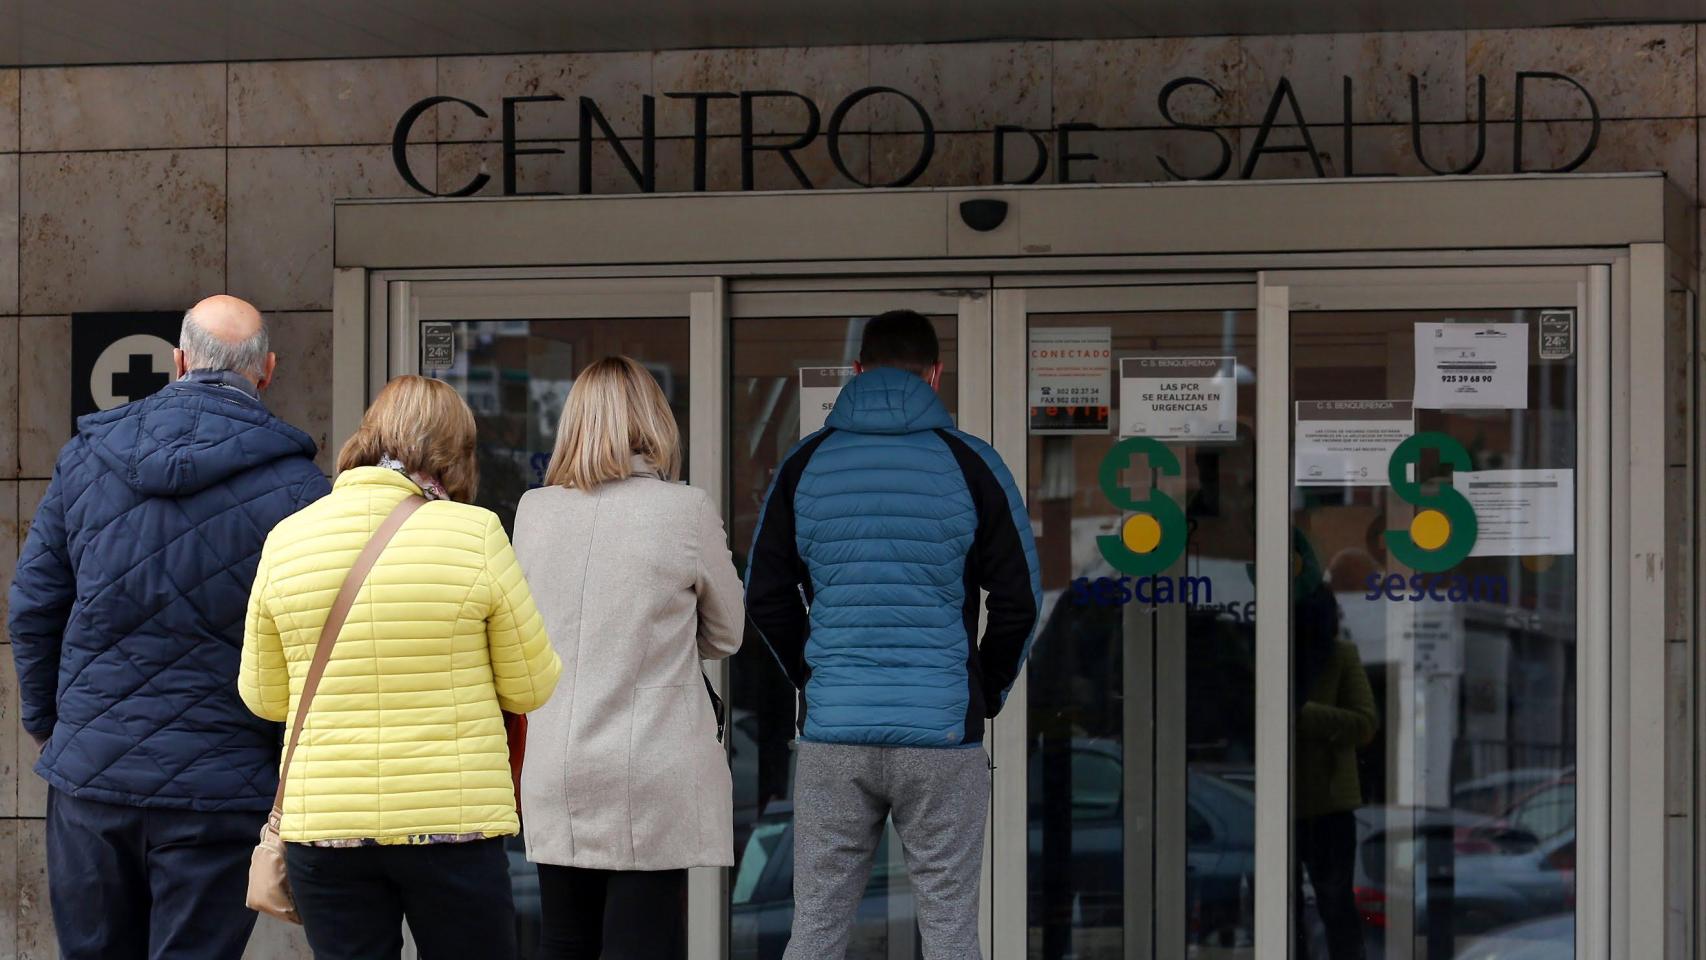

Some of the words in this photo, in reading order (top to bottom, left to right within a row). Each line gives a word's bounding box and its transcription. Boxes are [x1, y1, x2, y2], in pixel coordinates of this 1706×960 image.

[392, 86, 935, 197] CENTRO
[994, 123, 1098, 185] DE
[1156, 71, 1600, 182] SALUD
[1031, 350, 1110, 358] CONECTADO
[1158, 359, 1216, 368] BENQUERENCIA
[1441, 375, 1457, 383] 925
[1458, 375, 1468, 383] 39
[1470, 375, 1480, 383] 68
[1482, 375, 1492, 383] 90
[1160, 383, 1178, 391] LAS
[1180, 383, 1199, 391] PCR
[1142, 393, 1154, 401] SE
[1157, 393, 1204, 401] REALIZAN
[1208, 393, 1220, 401] EN
[1334, 401, 1394, 409] BENQUERENCIA
[1071, 575, 1212, 605] sescam
[1365, 572, 1509, 604] sescam
